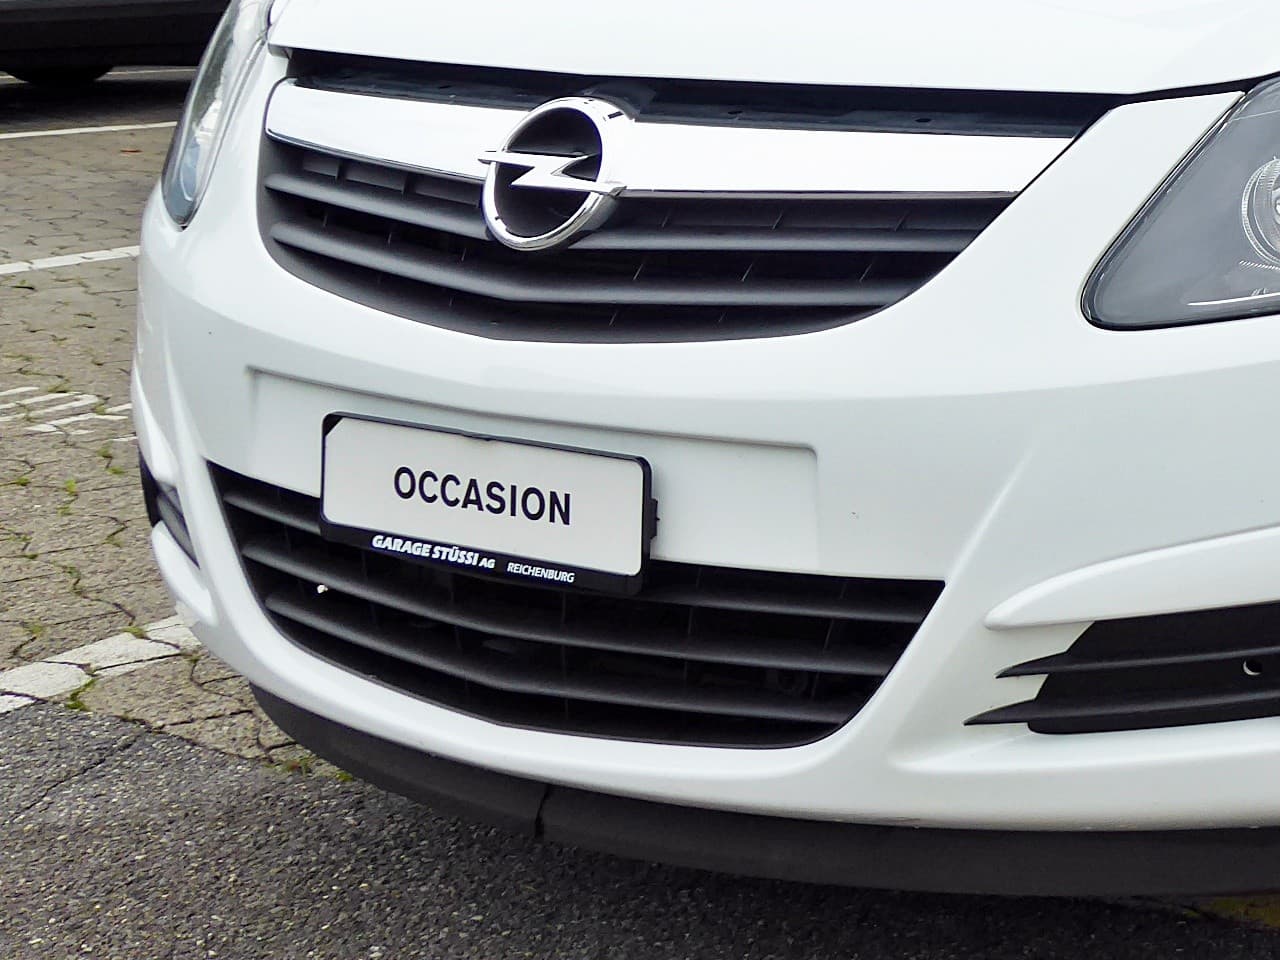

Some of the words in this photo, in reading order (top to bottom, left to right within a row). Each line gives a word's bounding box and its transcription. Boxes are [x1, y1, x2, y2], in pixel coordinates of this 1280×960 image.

[394, 466, 571, 526] OCCASION
[372, 535, 432, 557] GARAGE
[431, 545, 479, 566] STÜSSI
[479, 557, 496, 569] AG
[507, 562, 575, 584] REICHENBURG
